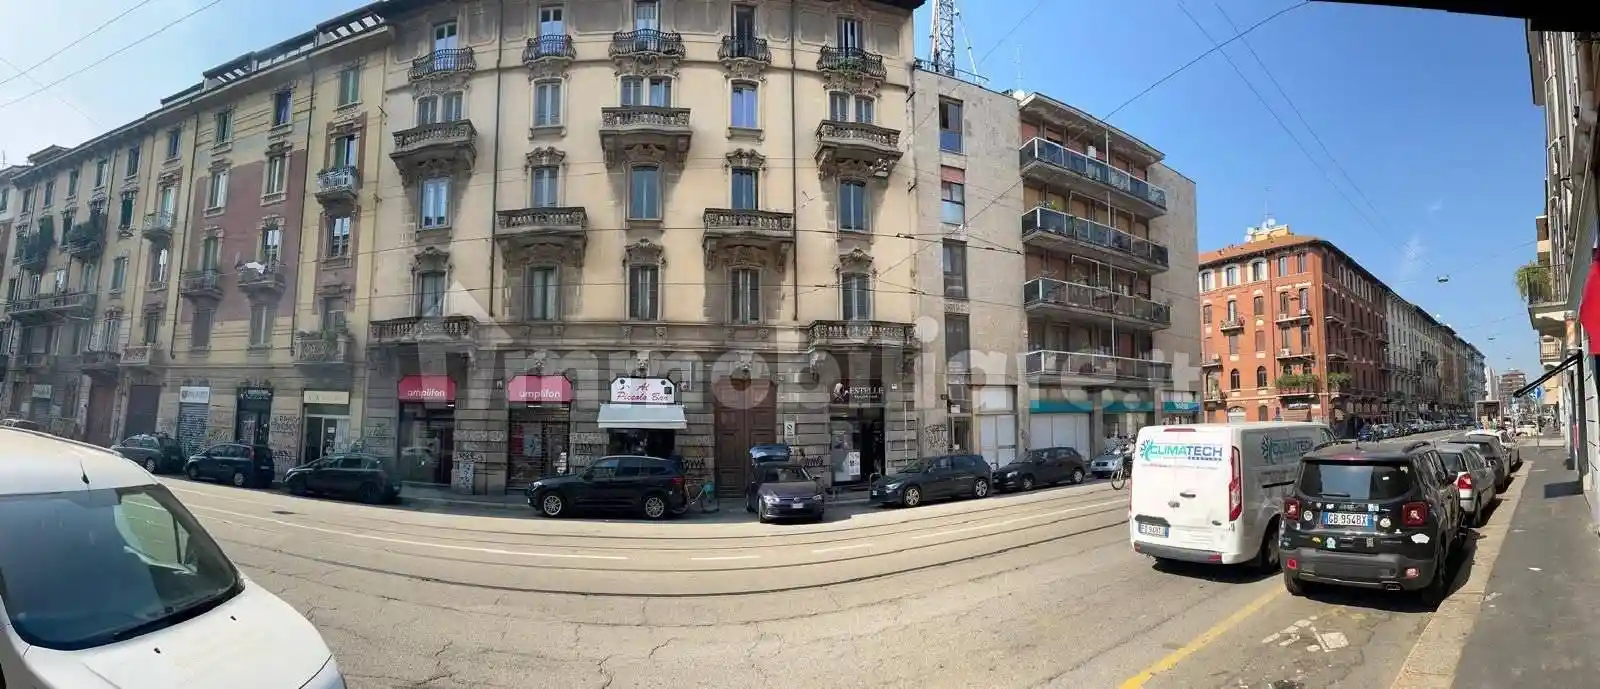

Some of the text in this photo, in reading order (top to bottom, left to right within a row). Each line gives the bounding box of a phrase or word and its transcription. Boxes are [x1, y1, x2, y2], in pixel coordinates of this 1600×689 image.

[406, 387, 446, 399] amplifon
[518, 387, 561, 399] amplifon
[848, 386, 885, 395] ESTELLE
[1152, 445, 1223, 458] CLIMATECH
